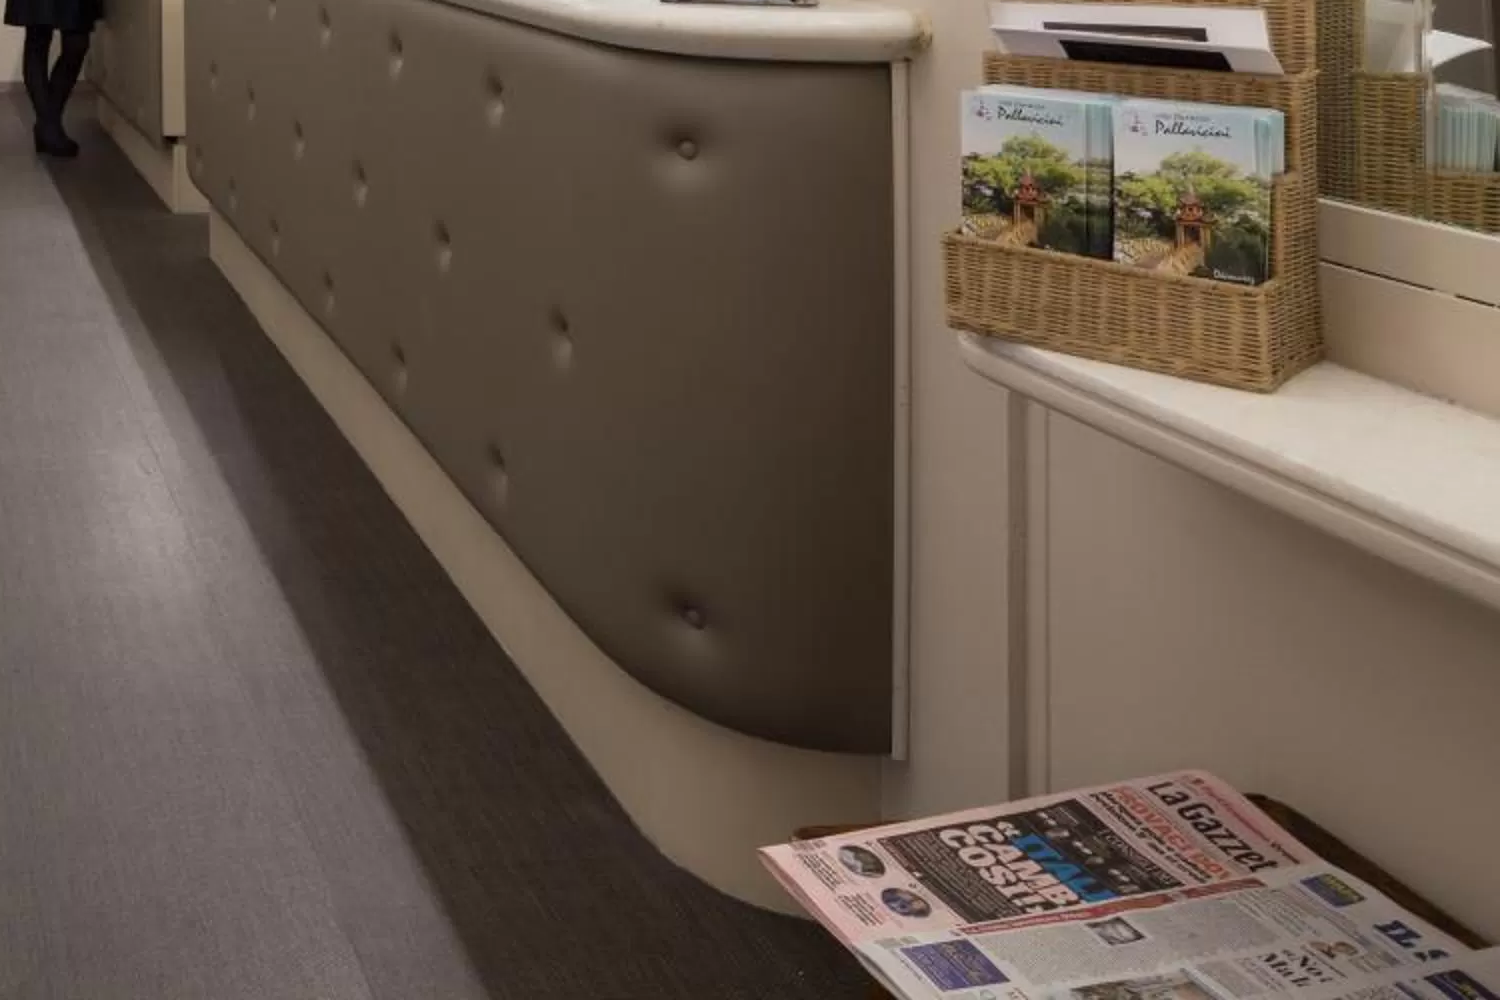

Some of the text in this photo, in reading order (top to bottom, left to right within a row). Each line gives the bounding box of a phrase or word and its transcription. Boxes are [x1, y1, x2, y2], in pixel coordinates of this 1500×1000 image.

[1155, 119, 1232, 137] Pallavicini
[1146, 781, 1184, 806] La
[968, 823, 1082, 903] CAMB
